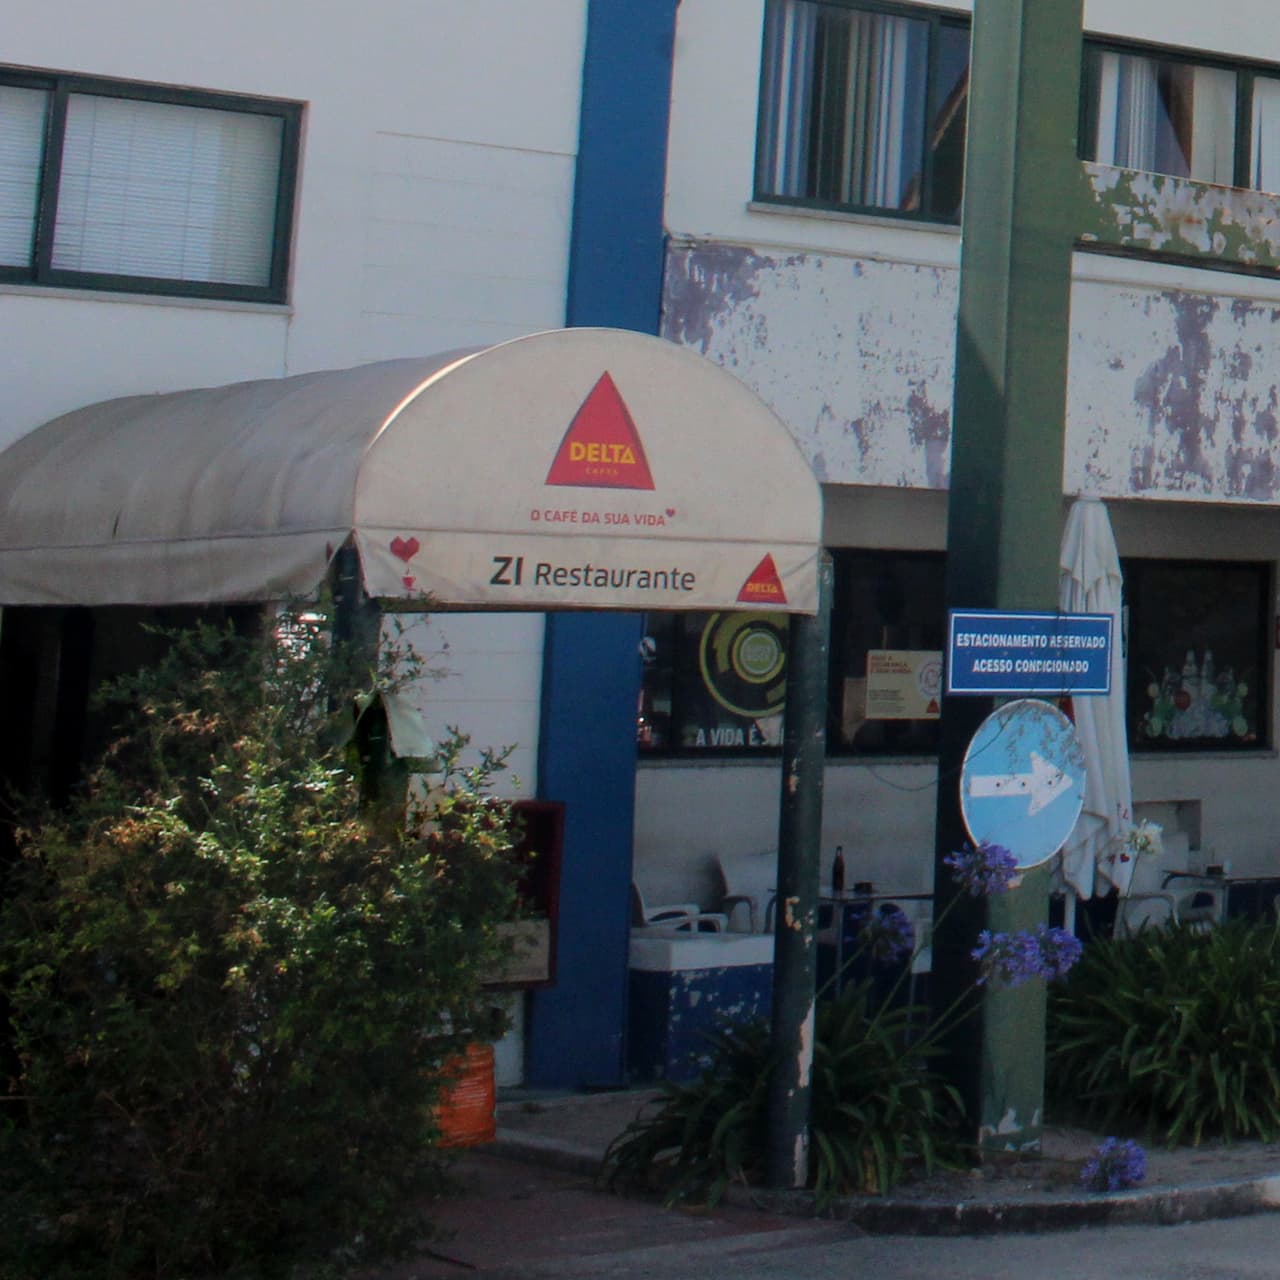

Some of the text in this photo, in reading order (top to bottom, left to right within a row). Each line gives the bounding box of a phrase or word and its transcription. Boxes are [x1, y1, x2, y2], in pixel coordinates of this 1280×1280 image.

[569, 441, 636, 465] DELTA
[531, 507, 666, 526] O CAFÉ DA SUA VIDA
[489, 556, 696, 591] ZI Restaurante
[746, 582, 778, 594] DELTA
[956, 633, 1048, 648] ESTACIONAMENTO
[972, 658, 1013, 673] ACESSO
[696, 728, 706, 747] A
[710, 728, 745, 747] VIDA
